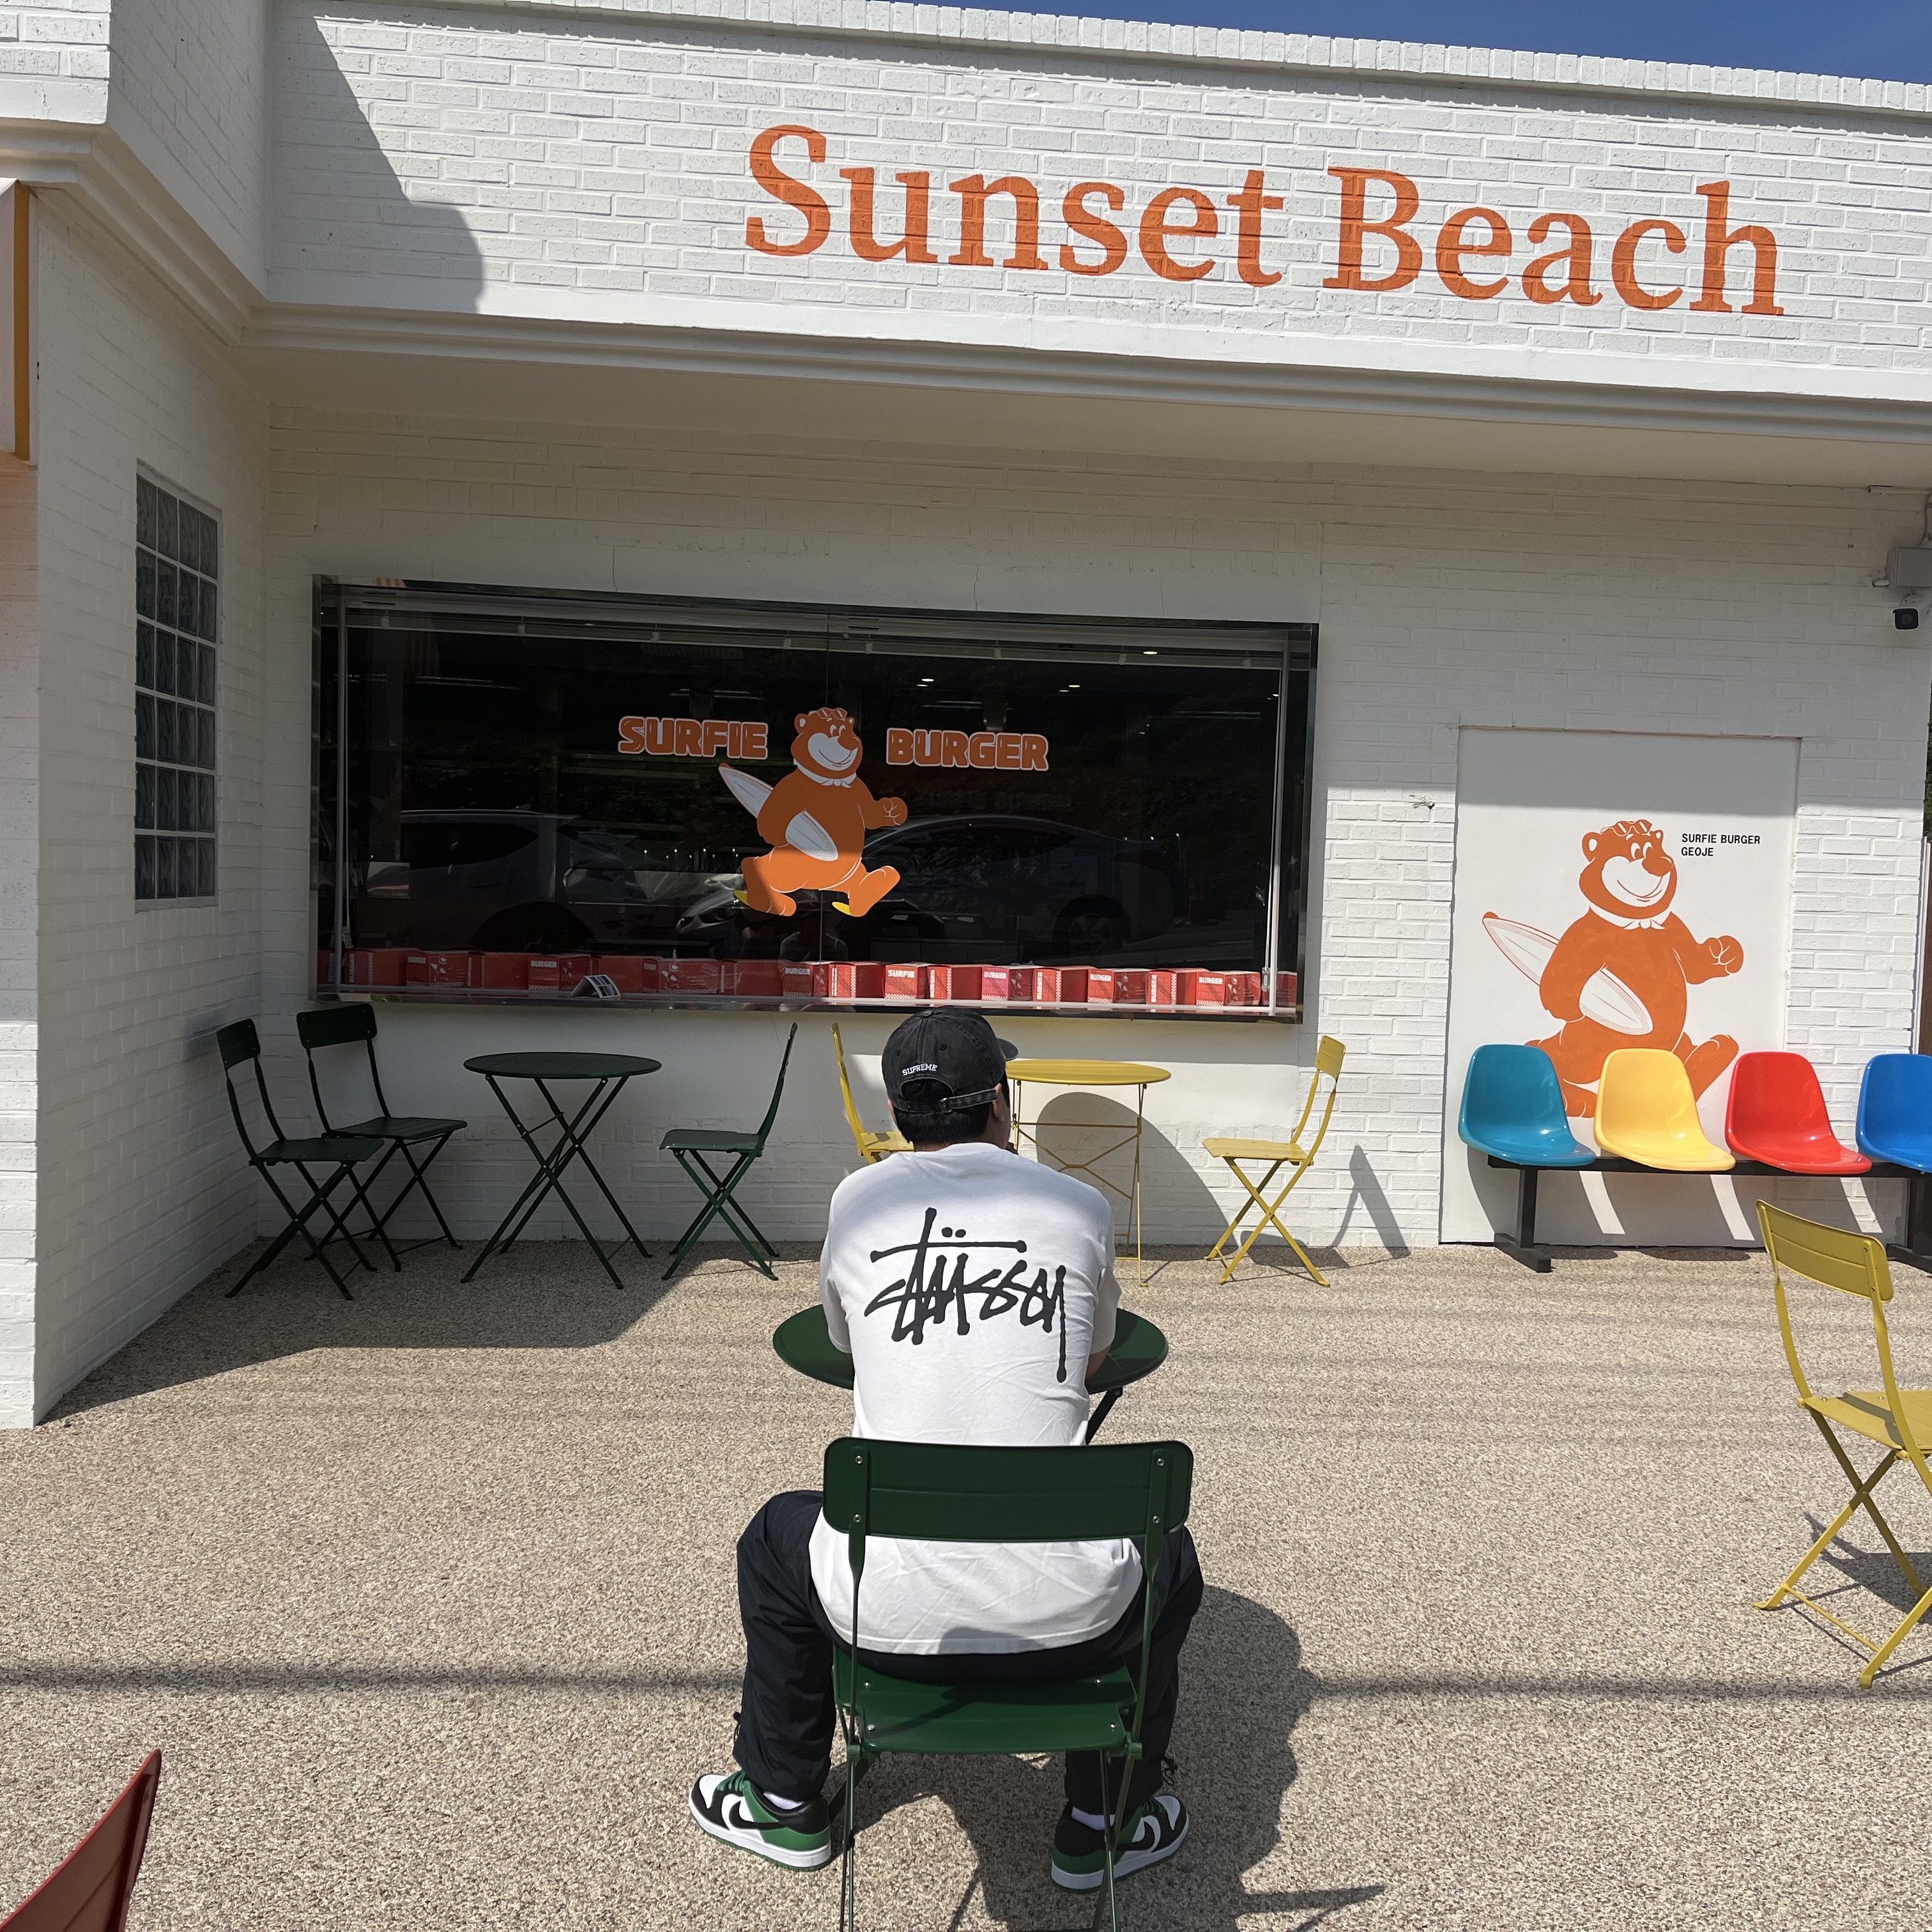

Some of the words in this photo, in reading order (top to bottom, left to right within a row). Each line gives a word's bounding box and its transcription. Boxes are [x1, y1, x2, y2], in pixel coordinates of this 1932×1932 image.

[746, 125, 1284, 288] Sunset
[1323, 166, 1784, 316] Beach
[618, 716, 769, 760] SURFIE
[886, 728, 1049, 770] BURGER
[1682, 834, 1717, 843] SURFIE
[1721, 834, 1760, 844] BURGER
[1681, 847, 1713, 856] GEOJE
[887, 969, 915, 978] SURFIE
[901, 1063, 938, 1076] SUPREME
